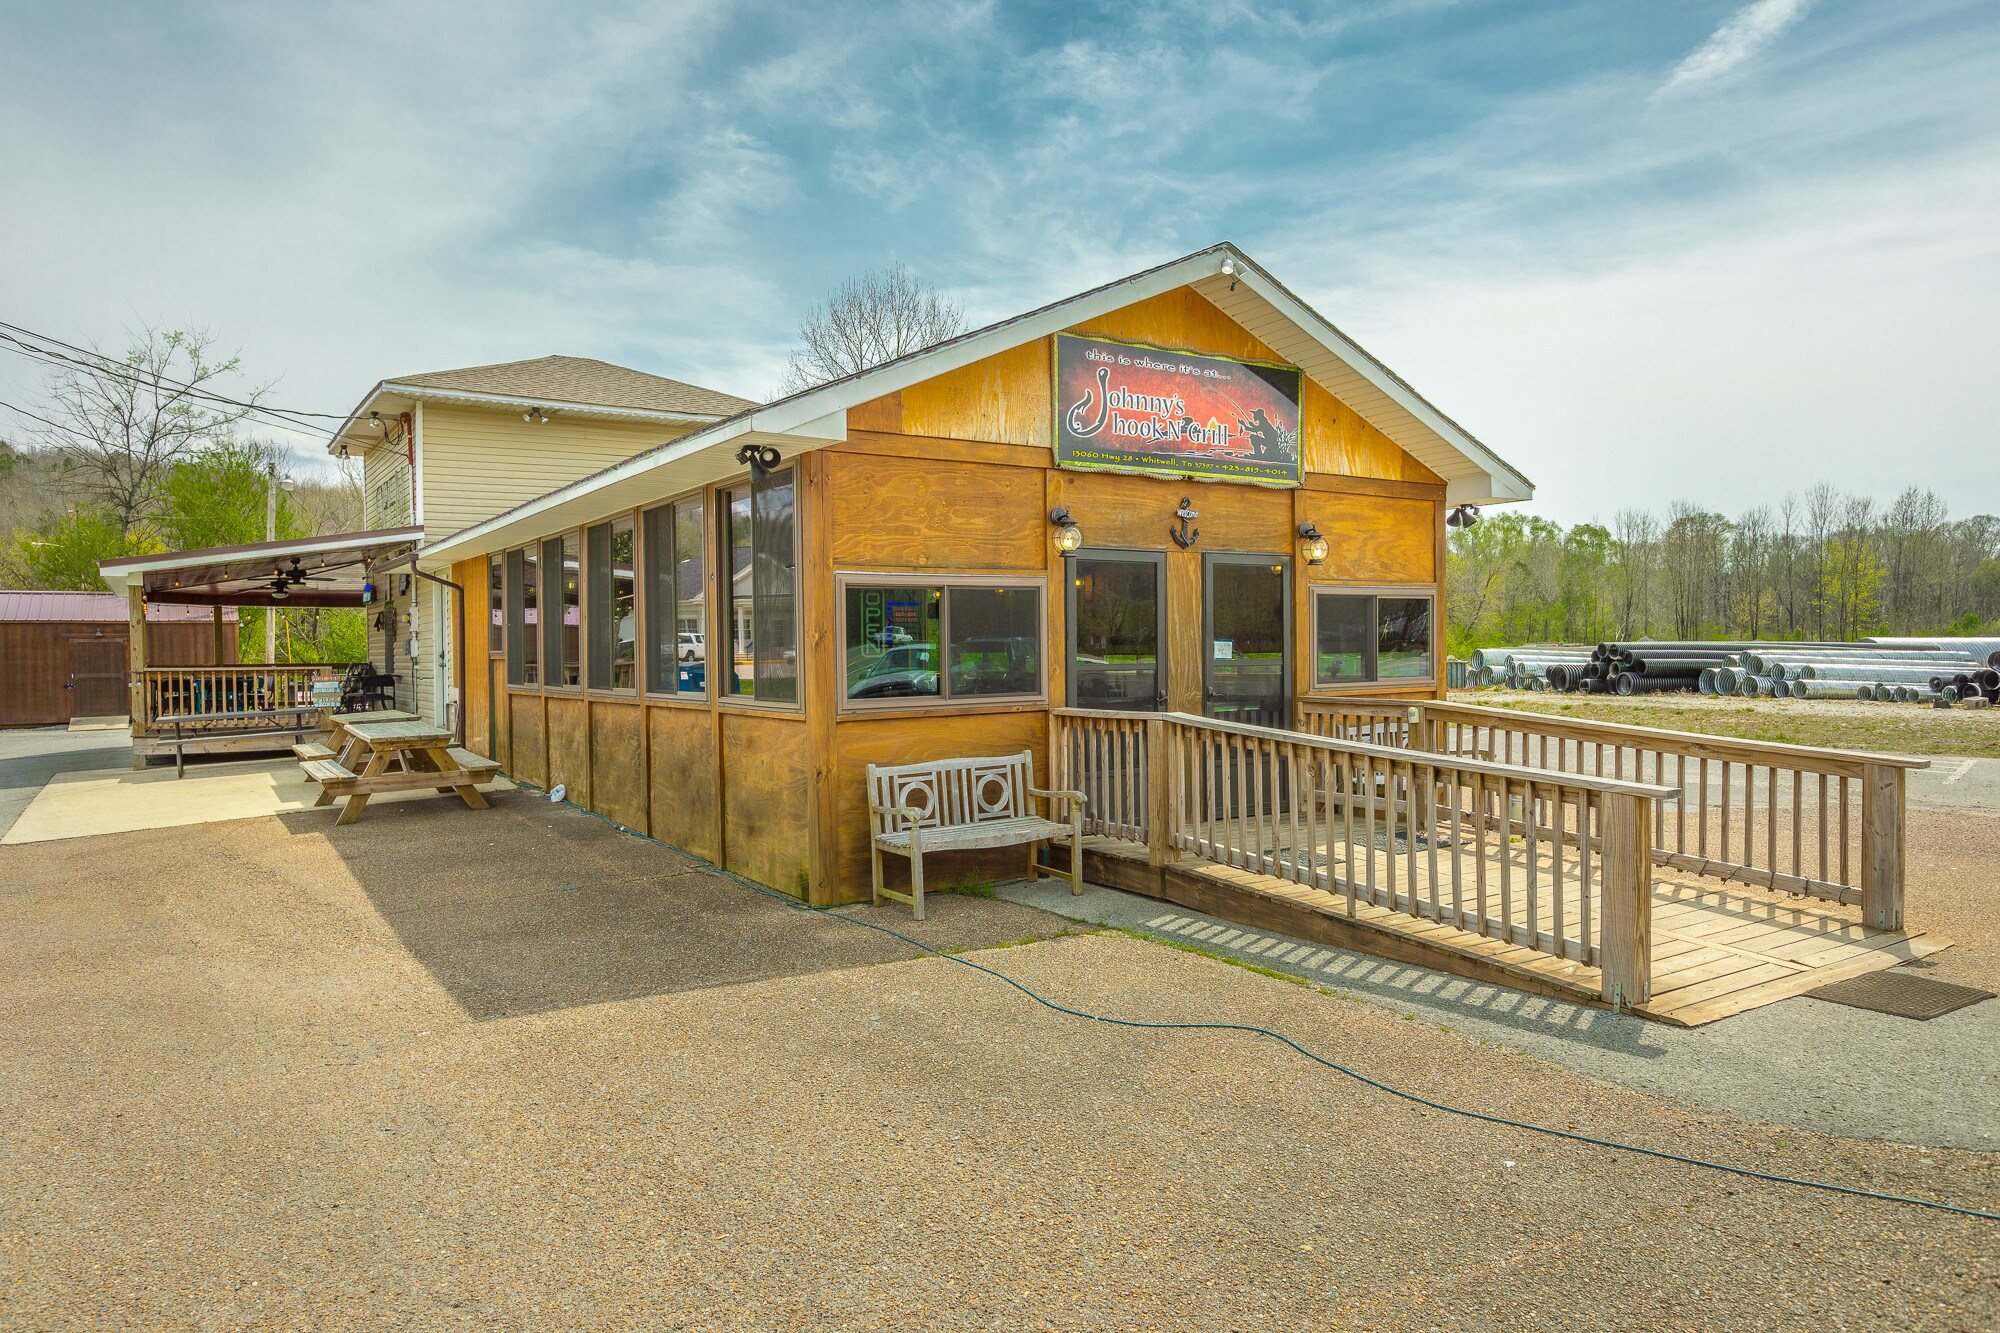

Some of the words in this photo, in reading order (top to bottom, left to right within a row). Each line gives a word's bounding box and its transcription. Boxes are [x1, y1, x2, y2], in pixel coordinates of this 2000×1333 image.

[1086, 349, 1115, 363] this
[1119, 354, 1131, 365] is
[1135, 357, 1176, 371] where
[1179, 363, 1200, 376] it's
[1203, 368, 1231, 380] at...
[1067, 367, 1185, 438] Johnny's
[1113, 412, 1164, 441] hook
[1188, 417, 1229, 446] Grill
[1071, 450, 1099, 459] 13060
[1101, 452, 1121, 463] Hwy
[1141, 455, 1179, 467] Whitwell,
[865, 592, 881, 655] OPEN
